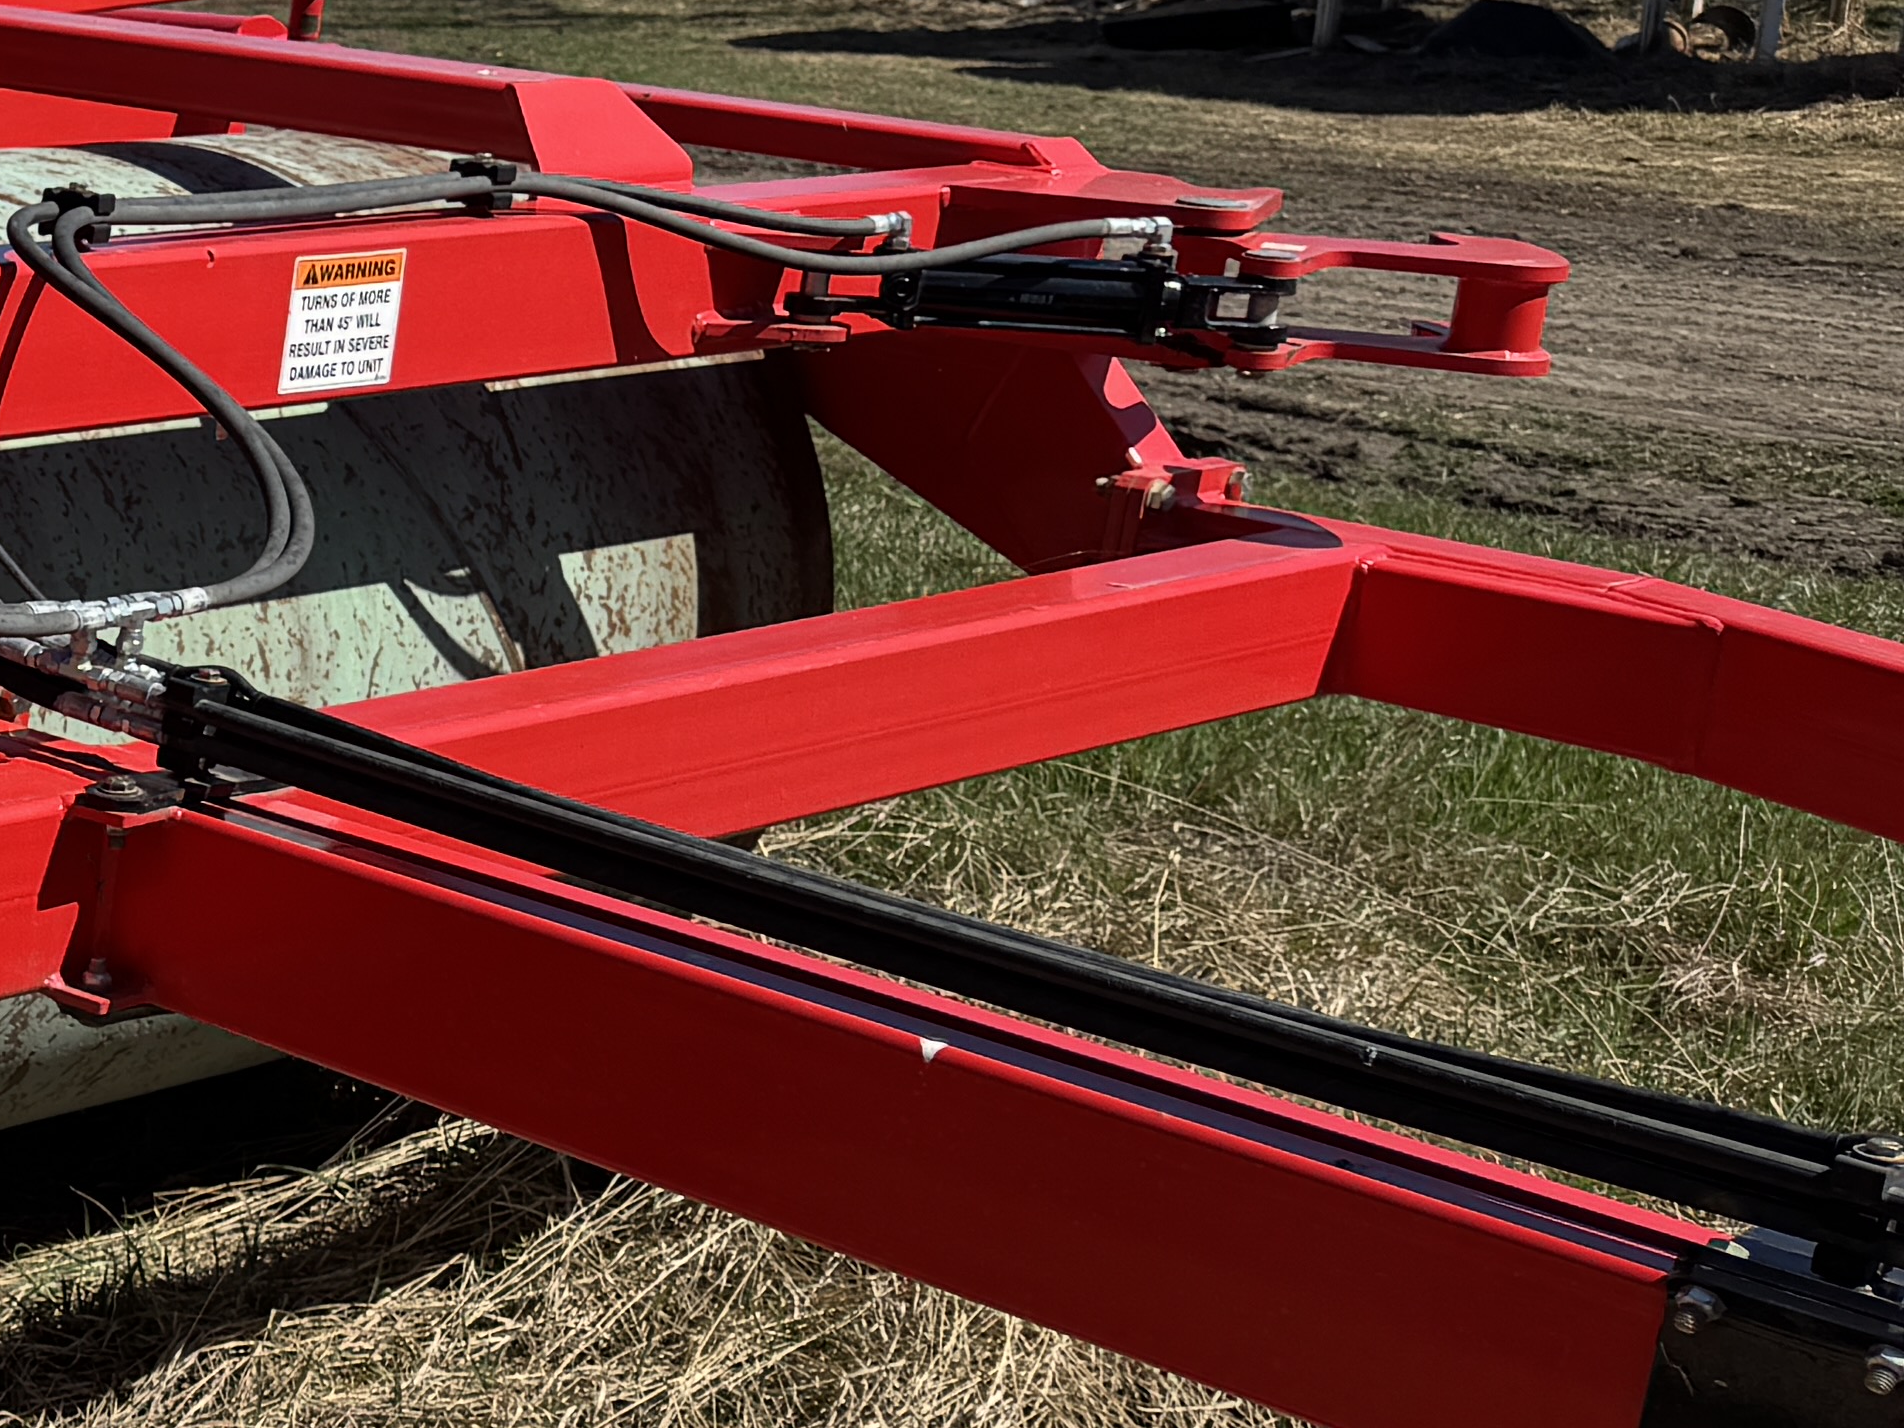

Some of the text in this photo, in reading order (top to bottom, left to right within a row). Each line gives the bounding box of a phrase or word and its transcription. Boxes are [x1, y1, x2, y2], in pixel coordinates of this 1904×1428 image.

[320, 259, 396, 282] WARNING
[302, 289, 391, 311] TURNS OF MORE
[305, 317, 334, 334] THAN
[356, 313, 381, 328] WILL
[289, 334, 389, 358] RESULT IN SEVERE
[290, 358, 384, 381] DAMAGE TO UNIT
